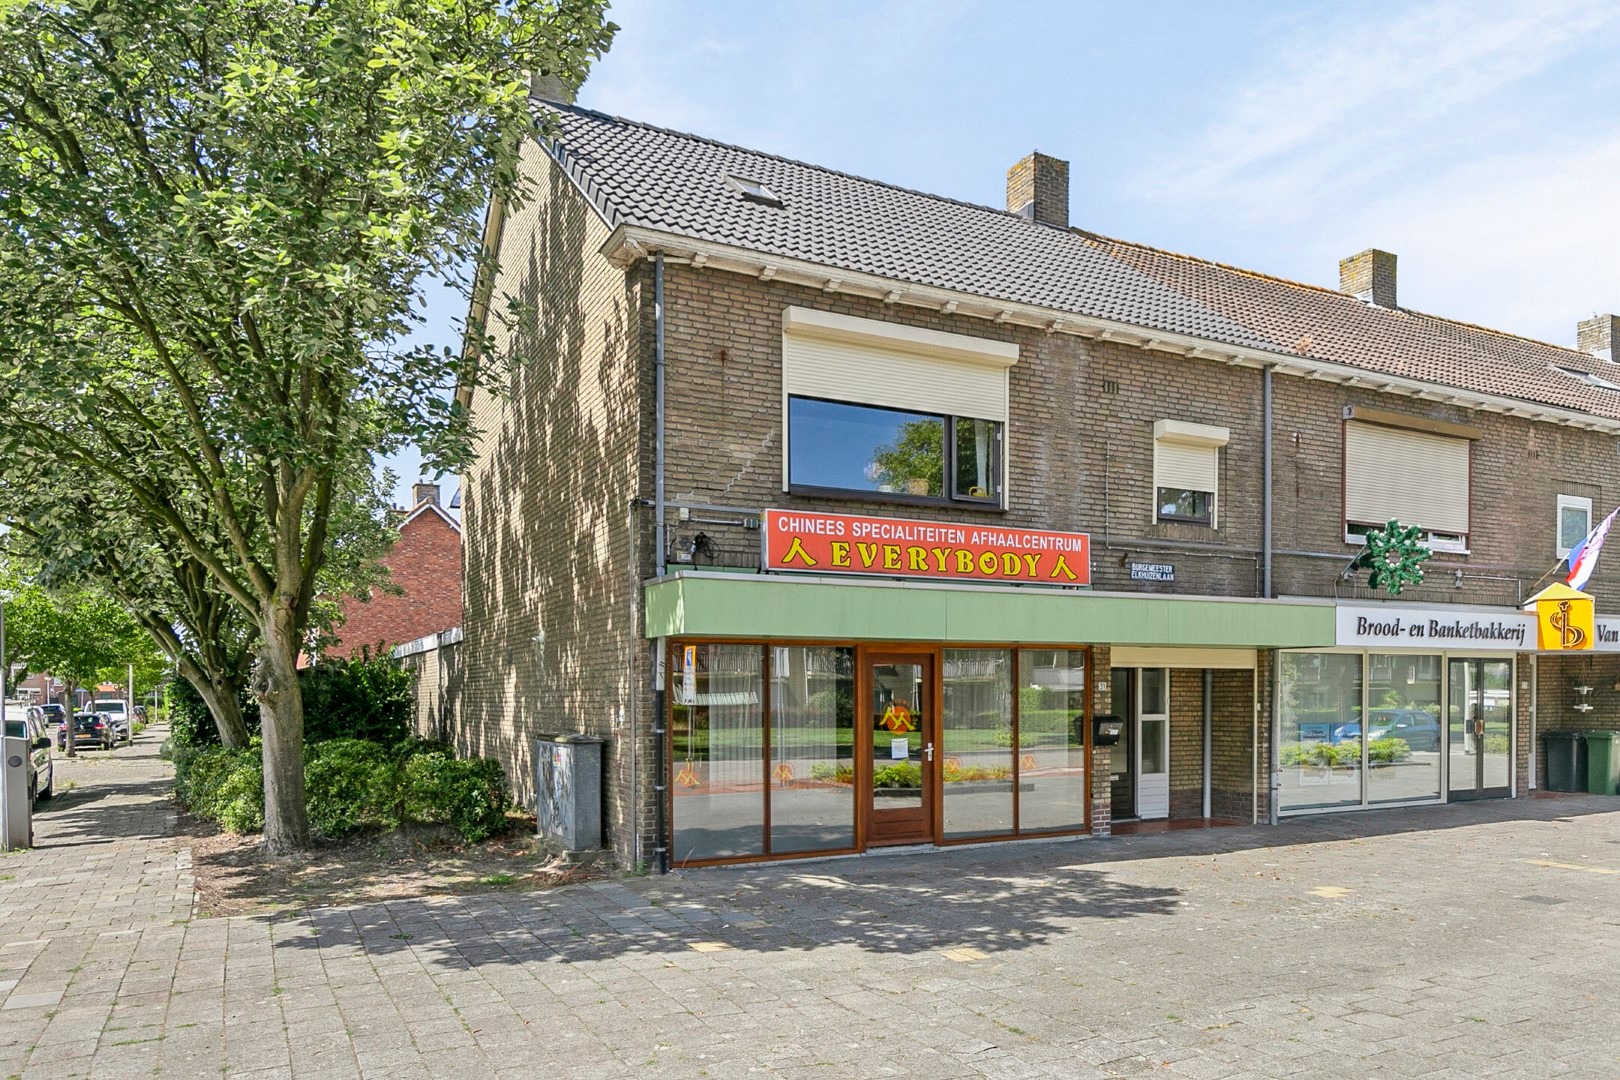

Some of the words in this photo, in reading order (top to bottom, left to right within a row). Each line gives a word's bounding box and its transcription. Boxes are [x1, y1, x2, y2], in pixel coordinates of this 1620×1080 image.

[778, 516, 845, 536] CHINEES
[852, 521, 965, 544] SPECIALITEITEN
[971, 531, 1082, 552] AFHAALCENTRUM
[830, 540, 1042, 578] EVERYBODY
[1131, 563, 1173, 573] BURGEMEESTER
[1357, 616, 1406, 637] Brood-
[1409, 624, 1425, 637] en
[1428, 619, 1526, 646] Banketbakkerij
[1597, 624, 1619, 643] Van
